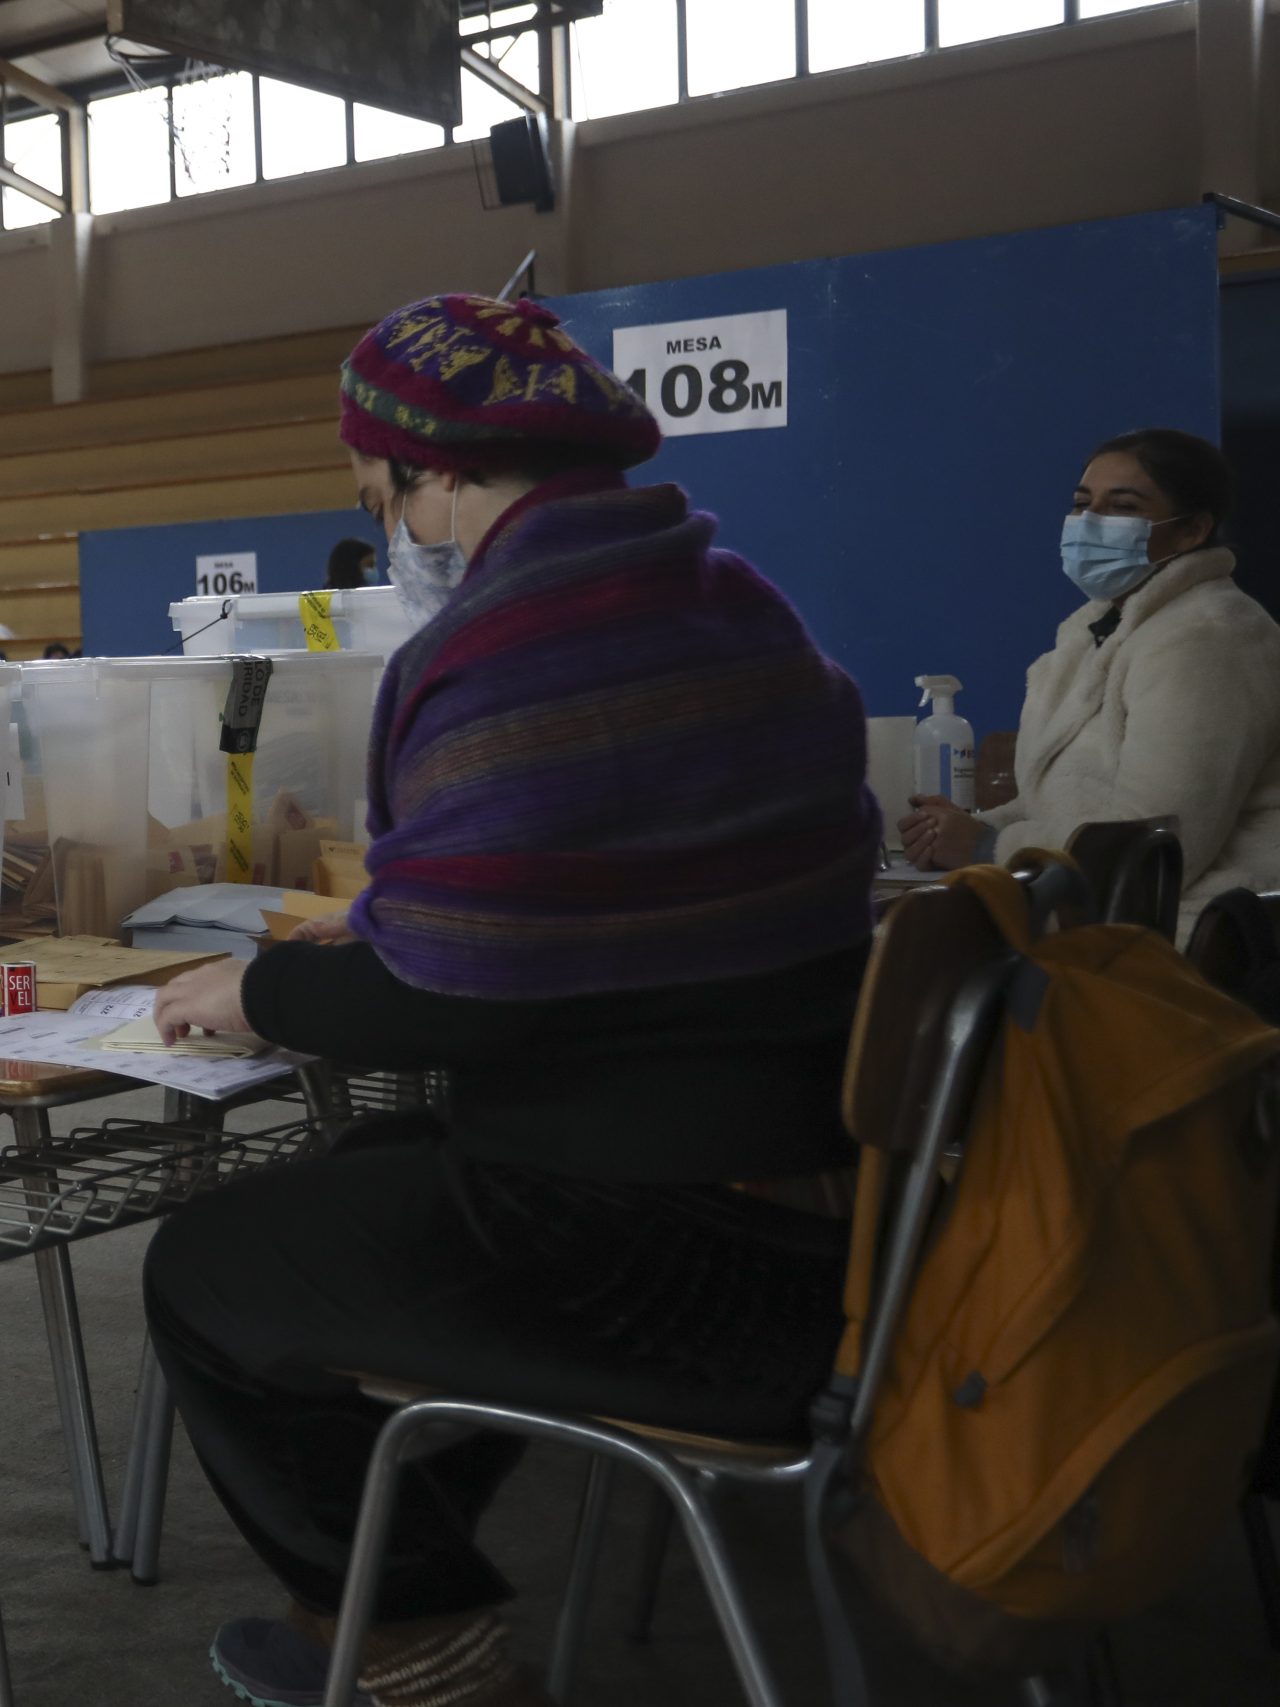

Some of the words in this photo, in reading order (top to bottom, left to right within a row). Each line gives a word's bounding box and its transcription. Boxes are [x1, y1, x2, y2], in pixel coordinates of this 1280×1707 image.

[666, 336, 722, 355] MESA
[626, 359, 783, 418] 108M
[198, 572, 255, 595] 106M
[8, 975, 31, 991] SER
